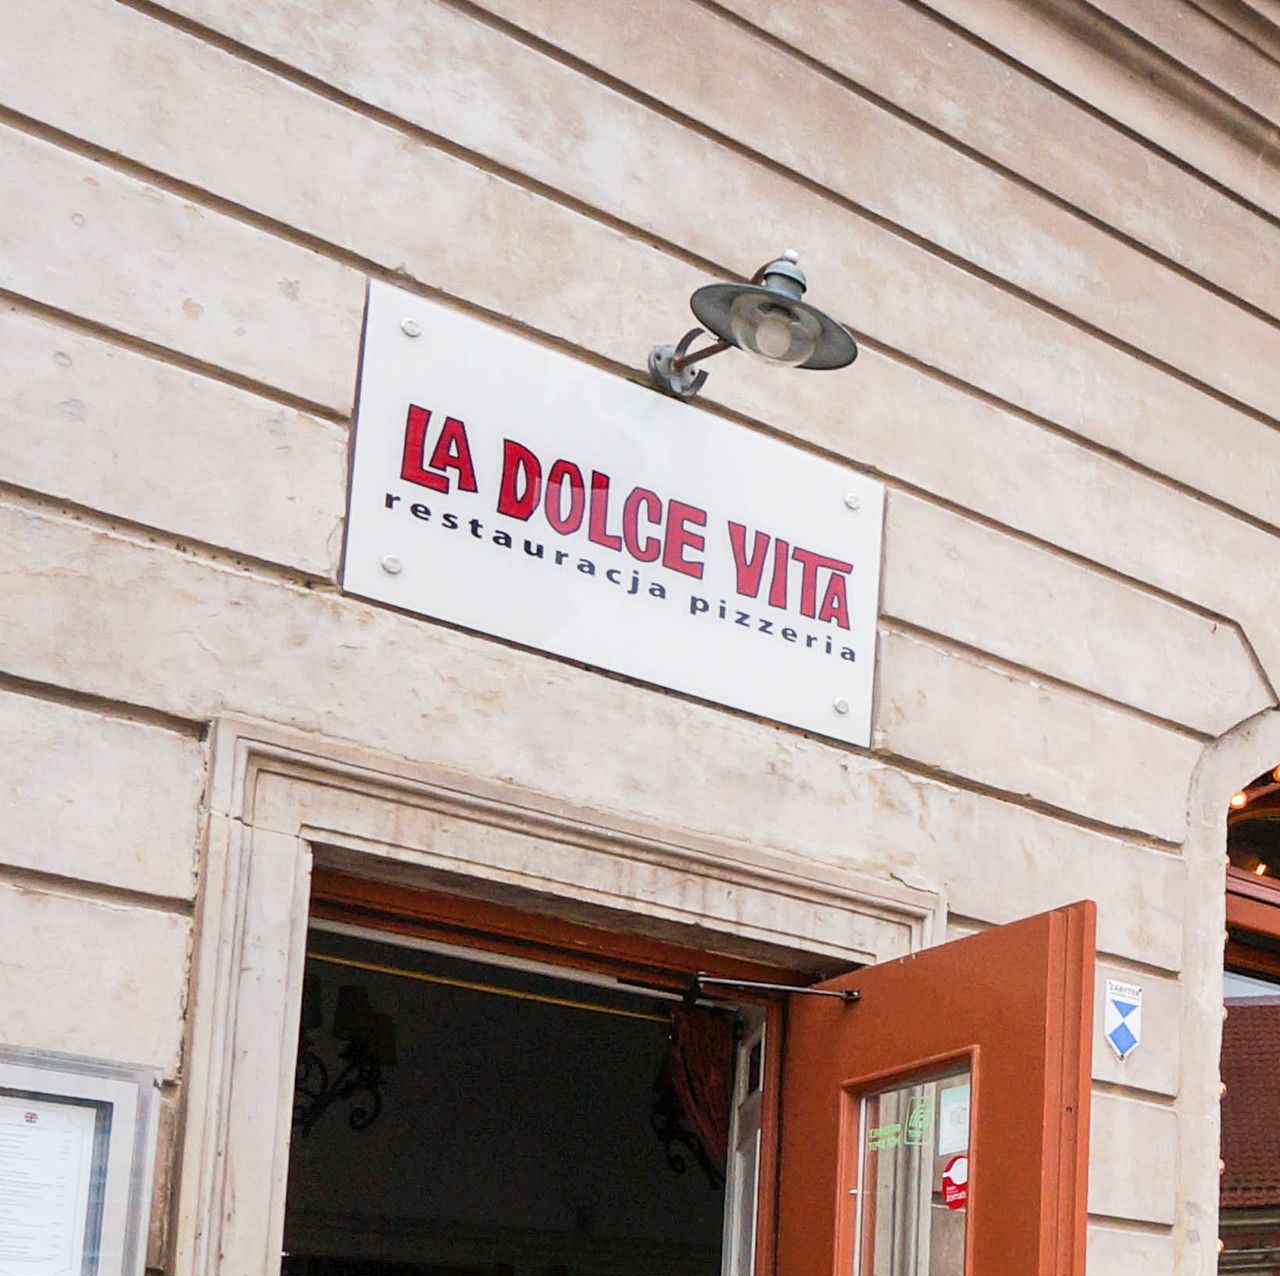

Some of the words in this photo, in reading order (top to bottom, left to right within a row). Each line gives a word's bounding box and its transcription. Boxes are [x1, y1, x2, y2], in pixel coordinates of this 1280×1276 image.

[384, 491, 667, 600] restauracja
[689, 593, 857, 663] pizzeria
[400, 403, 478, 494] LA
[496, 438, 708, 580] DOLCE
[727, 520, 854, 630] VITA
